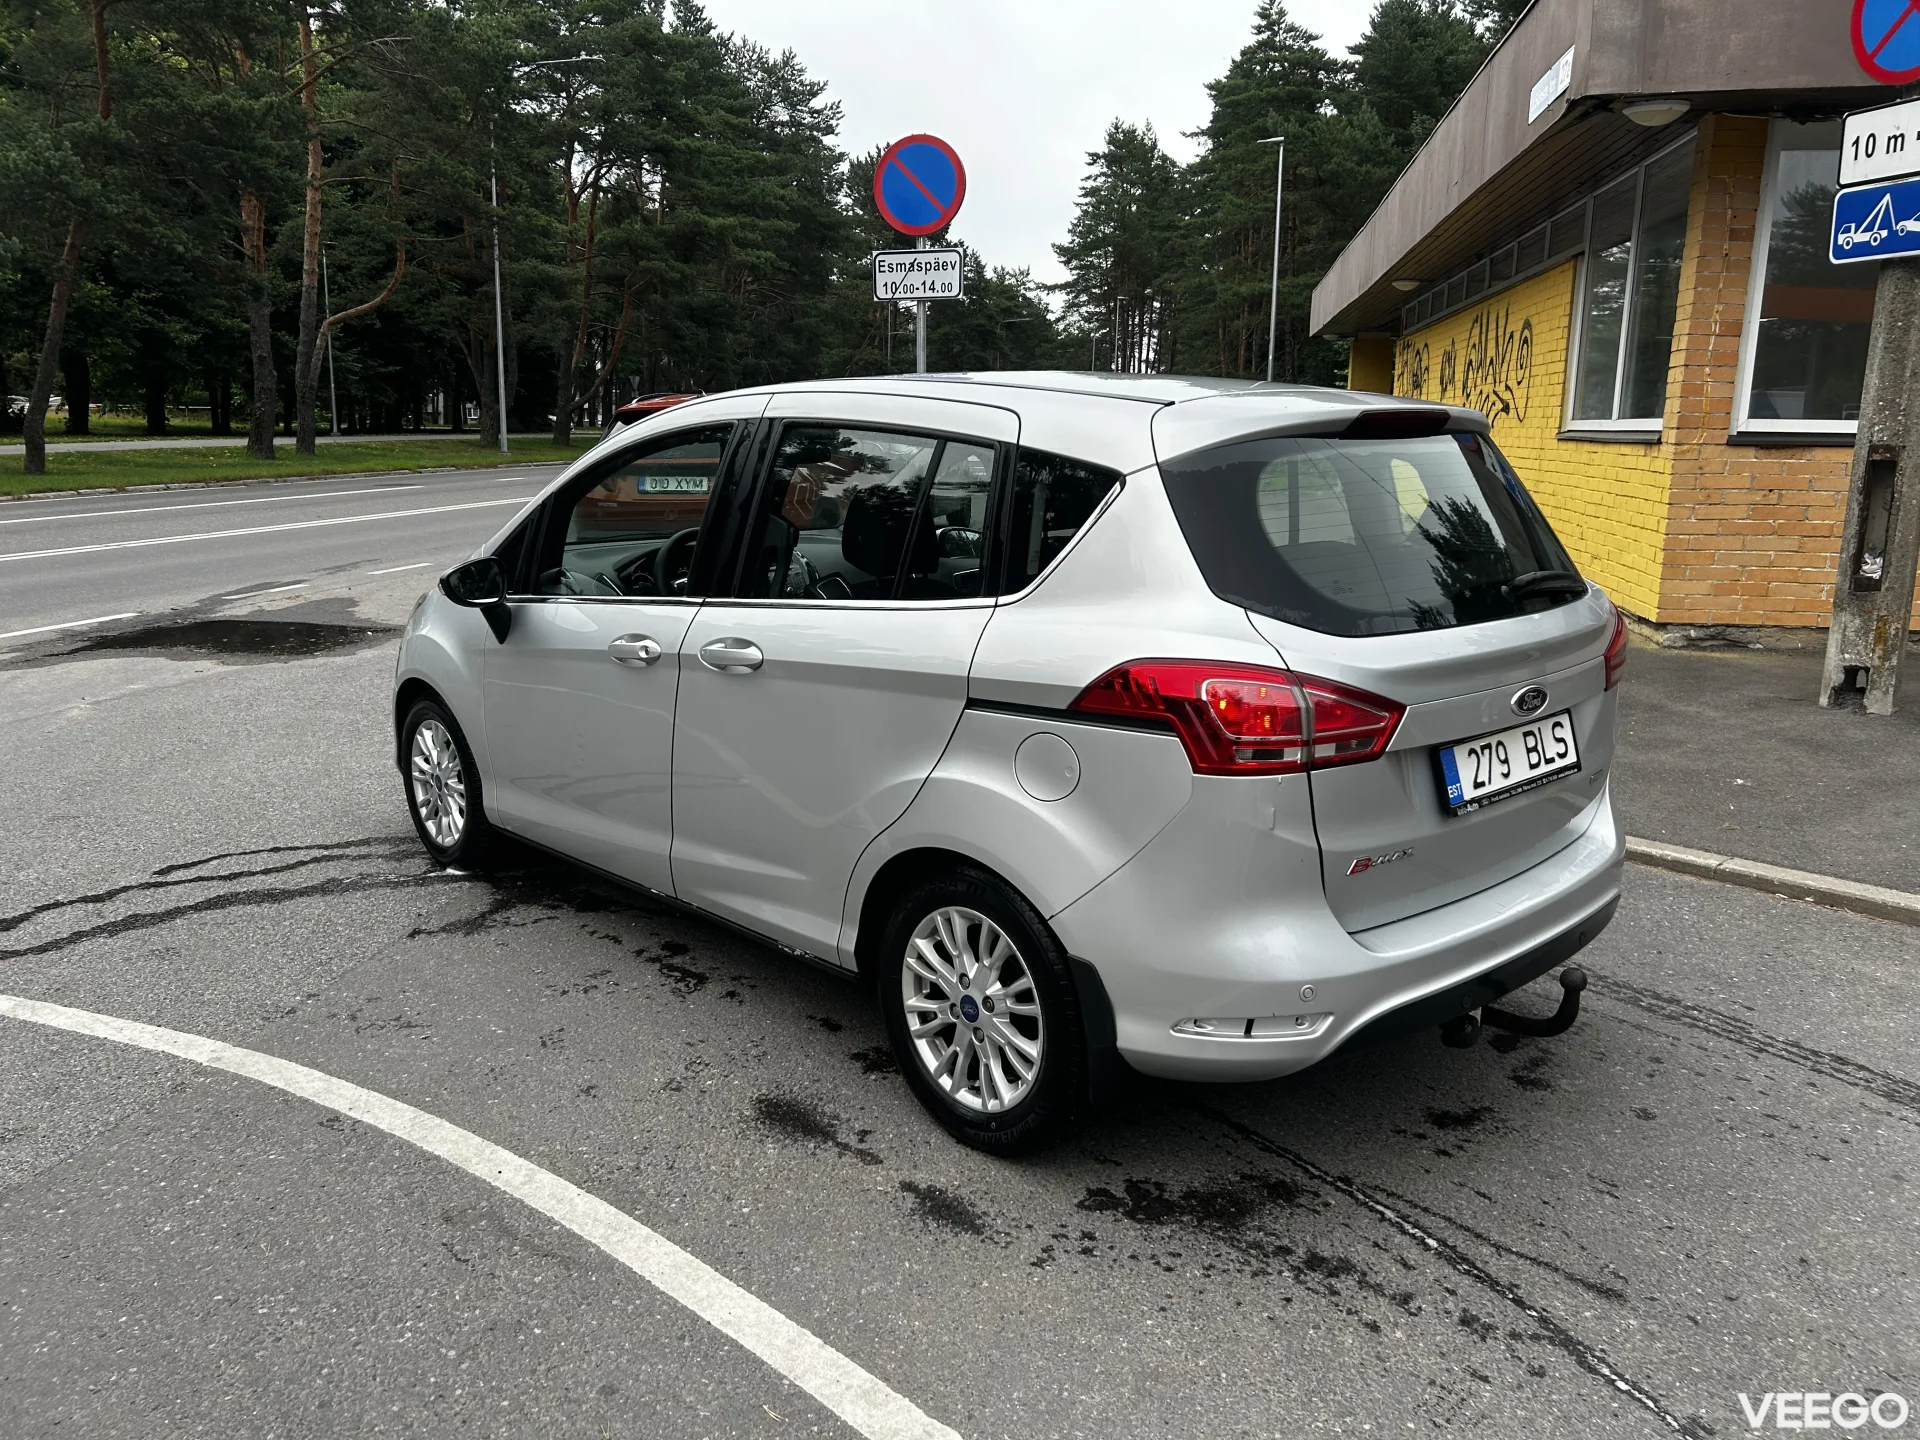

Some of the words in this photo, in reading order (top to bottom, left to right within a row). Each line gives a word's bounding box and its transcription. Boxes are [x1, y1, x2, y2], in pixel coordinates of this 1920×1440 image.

[1851, 132, 1876, 161] 10
[1885, 132, 1905, 154] m
[878, 257, 957, 275] Esmaspäev
[882, 279, 953, 295] 10.00-14.00
[1522, 691, 1543, 710] Ford
[1467, 739, 1511, 790] 279
[1522, 721, 1569, 771] BLS
[1447, 783, 1461, 798] EST
